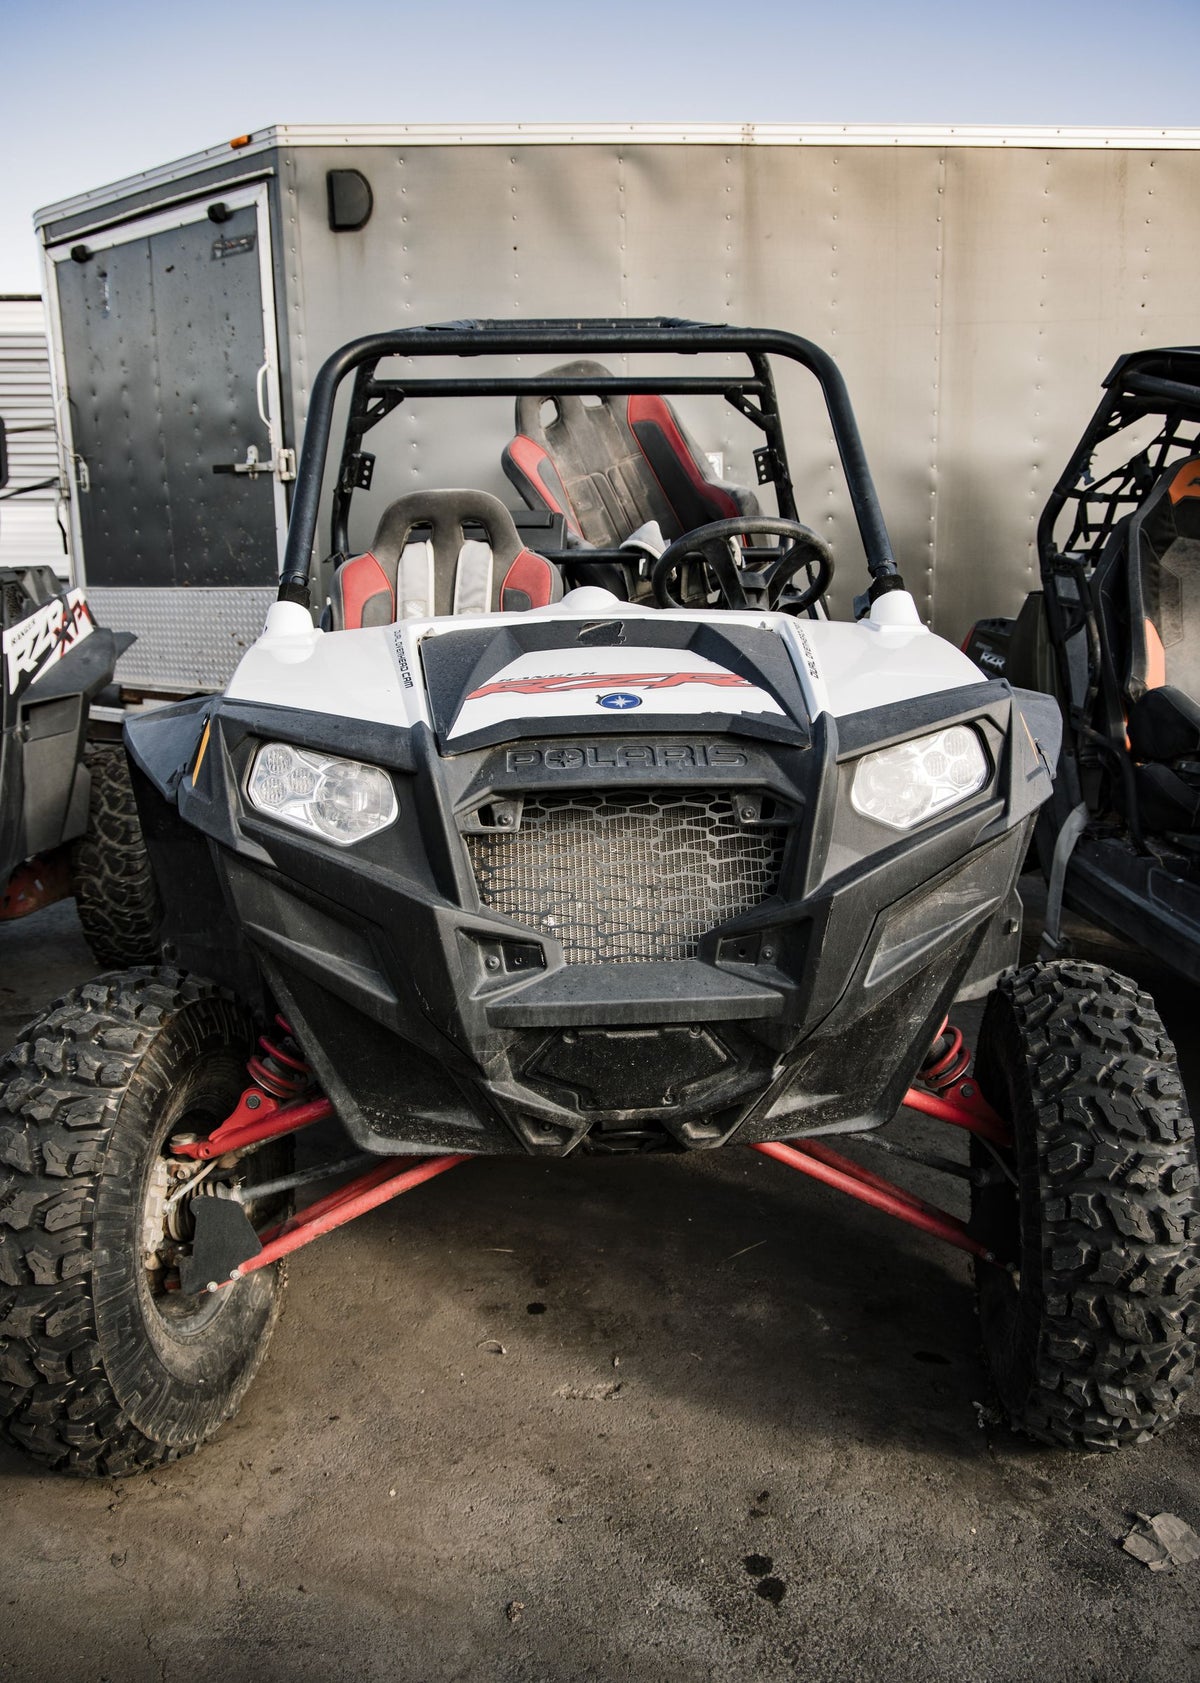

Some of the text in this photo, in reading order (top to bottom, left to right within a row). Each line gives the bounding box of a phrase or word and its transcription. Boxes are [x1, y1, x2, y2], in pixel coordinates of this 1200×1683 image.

[980, 651, 1006, 670] RZR
[402, 671, 414, 689] CAM
[465, 672, 758, 701] RZR
[506, 745, 747, 773] POLARIS
